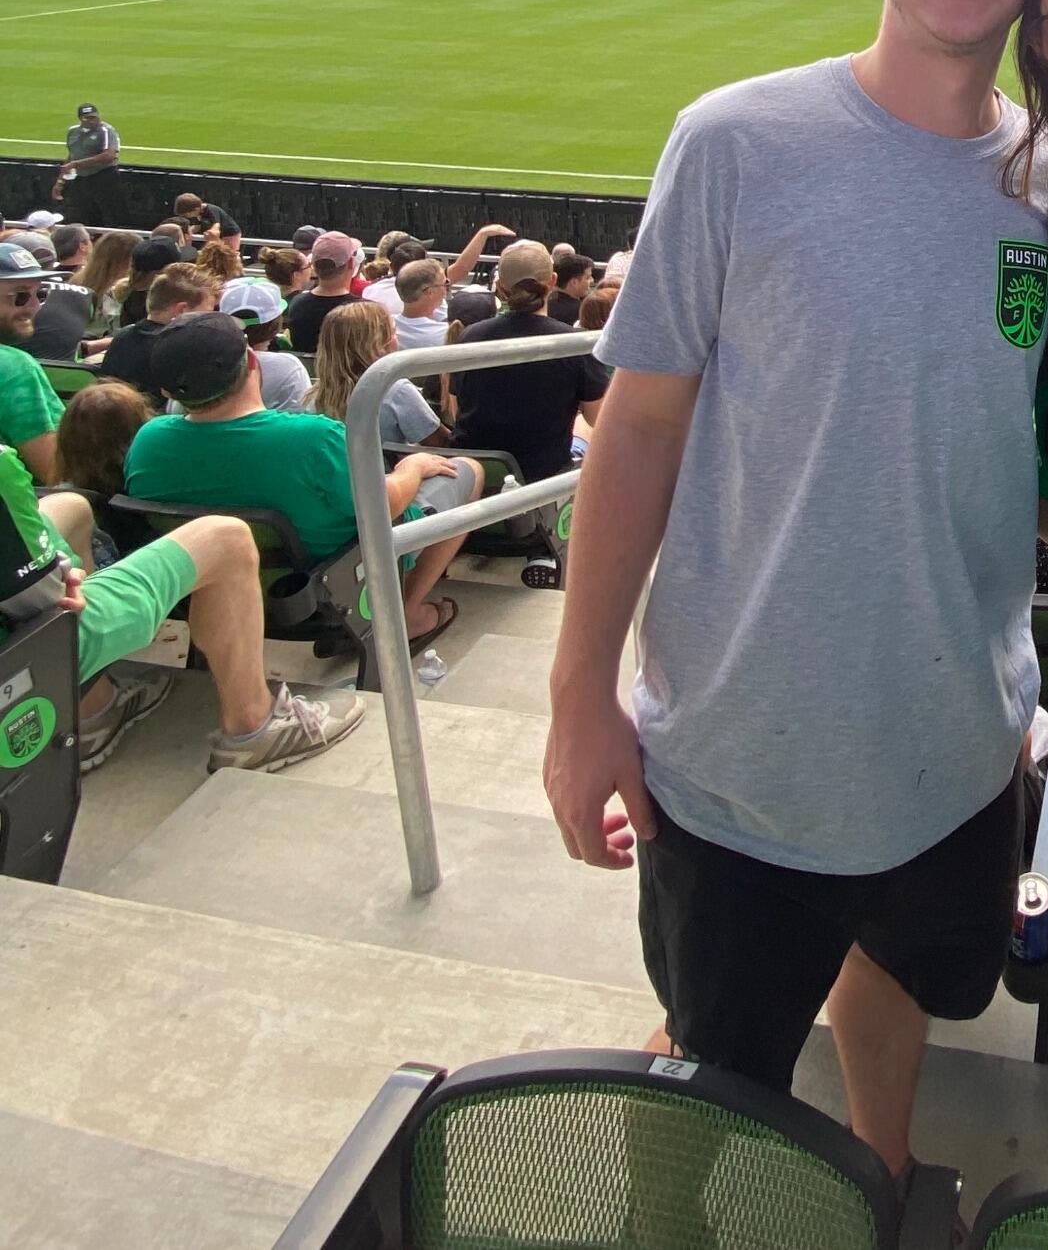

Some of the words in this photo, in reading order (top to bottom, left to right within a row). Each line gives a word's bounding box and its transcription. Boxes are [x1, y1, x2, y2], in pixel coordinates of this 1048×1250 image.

[1006, 249, 1048, 268] AUSTIN
[8, 709, 36, 733] AUSTIN
[662, 1060, 685, 1075] 22
